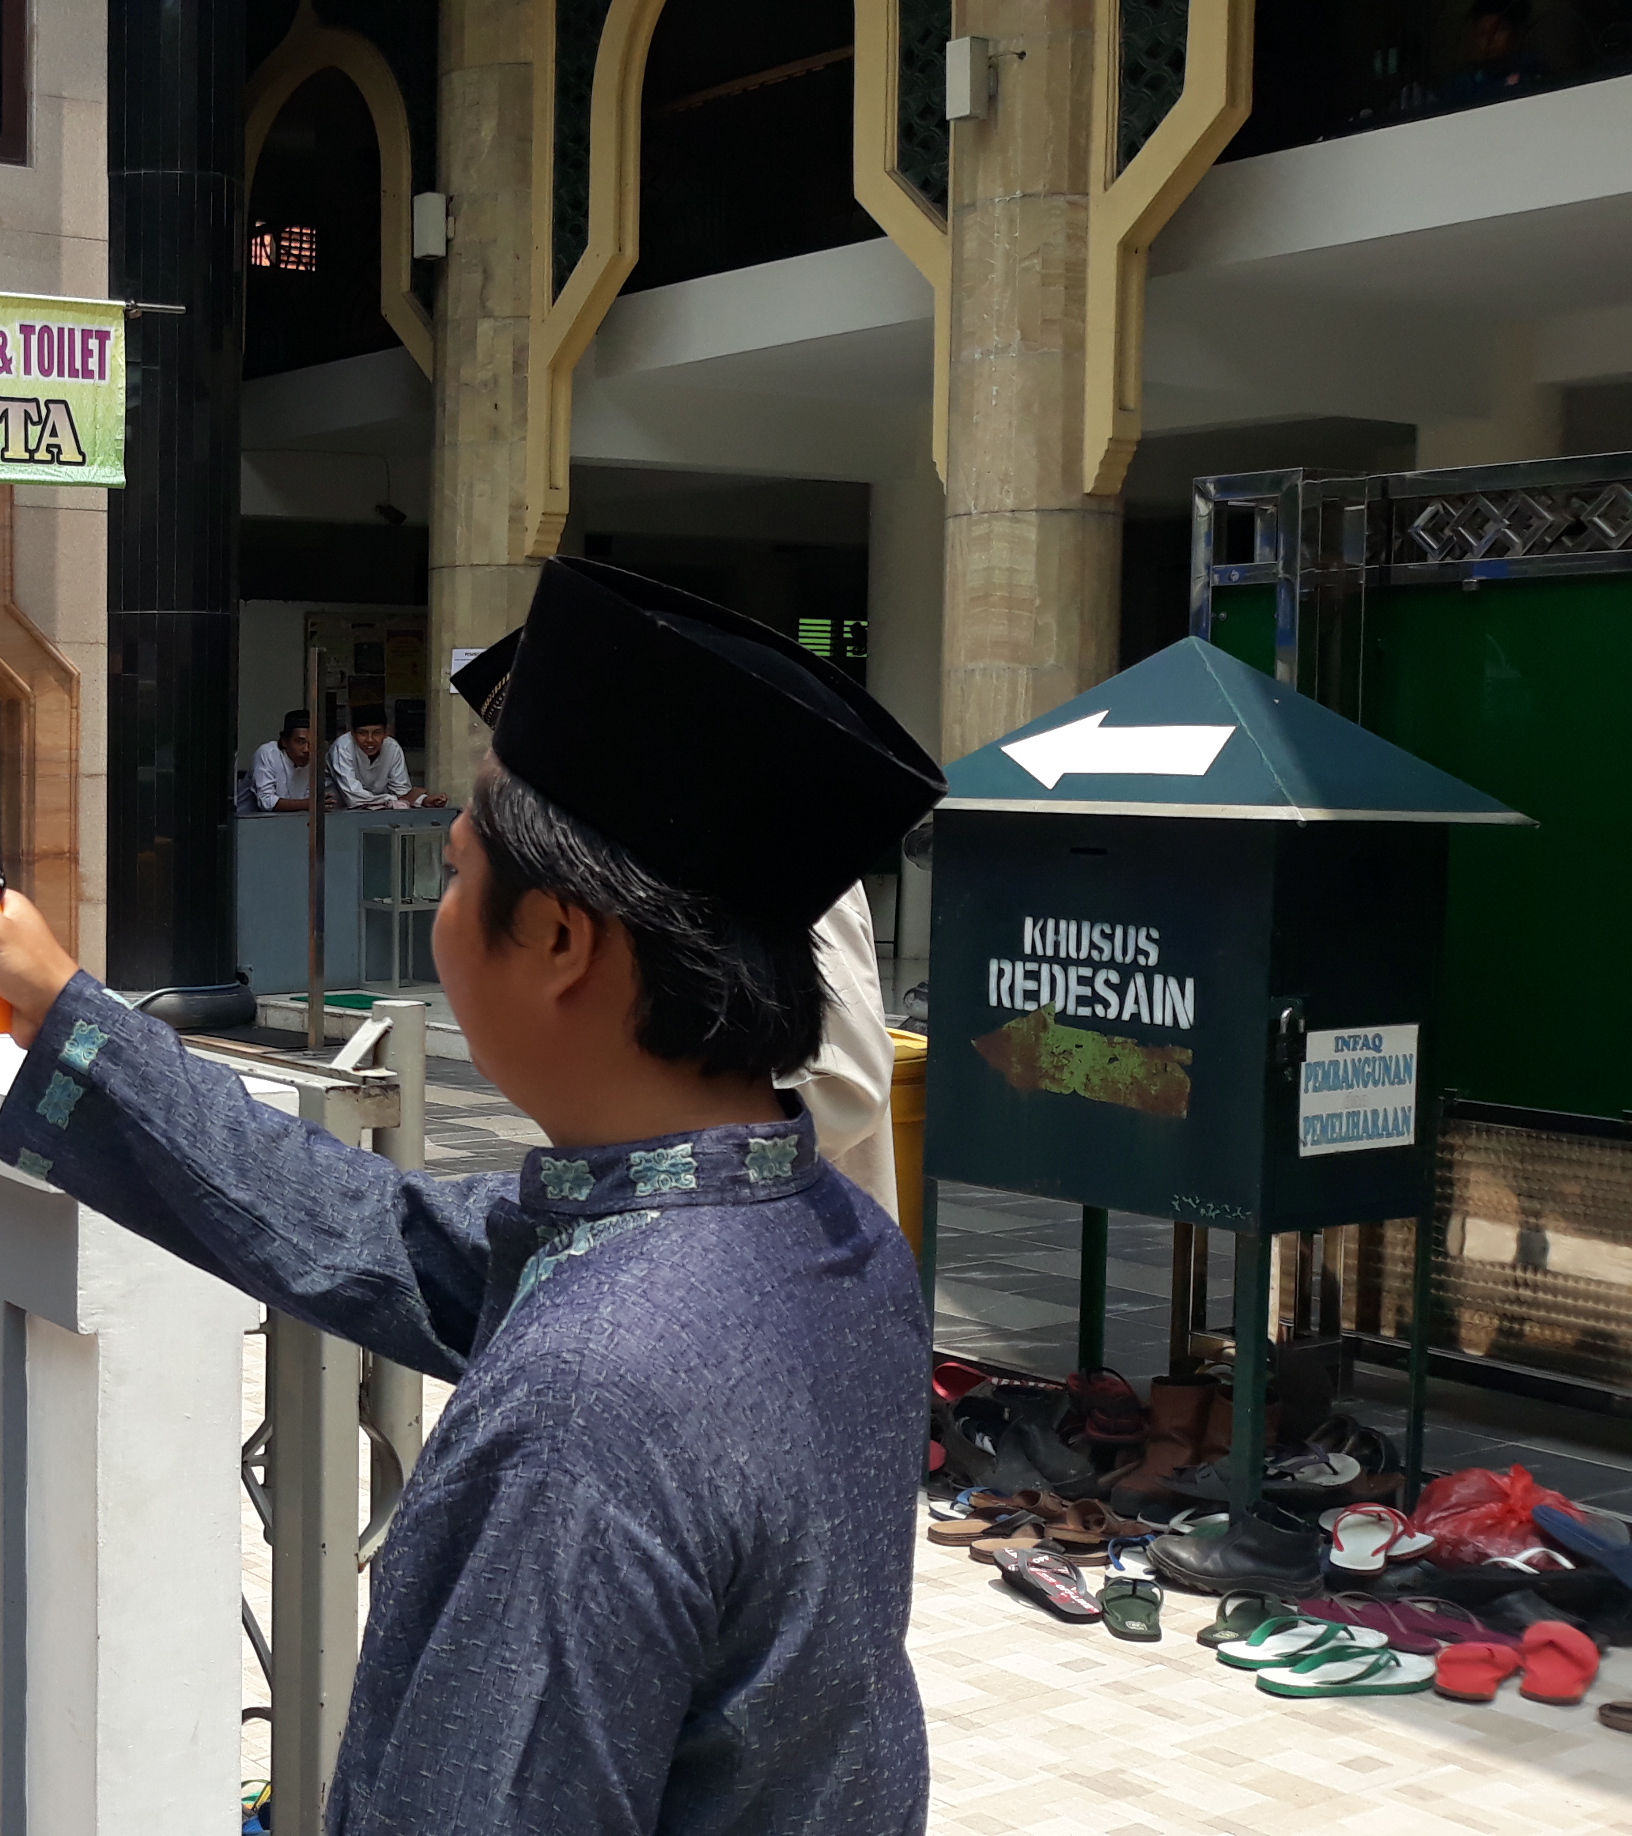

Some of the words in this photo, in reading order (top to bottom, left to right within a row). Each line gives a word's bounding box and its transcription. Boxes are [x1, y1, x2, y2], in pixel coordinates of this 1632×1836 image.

[18, 323, 112, 381] TOILET
[1023, 915, 1161, 967] KHUSUS
[988, 957, 1195, 1031] REDESAIN
[1333, 1032, 1384, 1054] INFAQ
[1303, 1053, 1414, 1094] PEMBANGUNAN
[1302, 1105, 1413, 1147] PEMELIHARAAN
